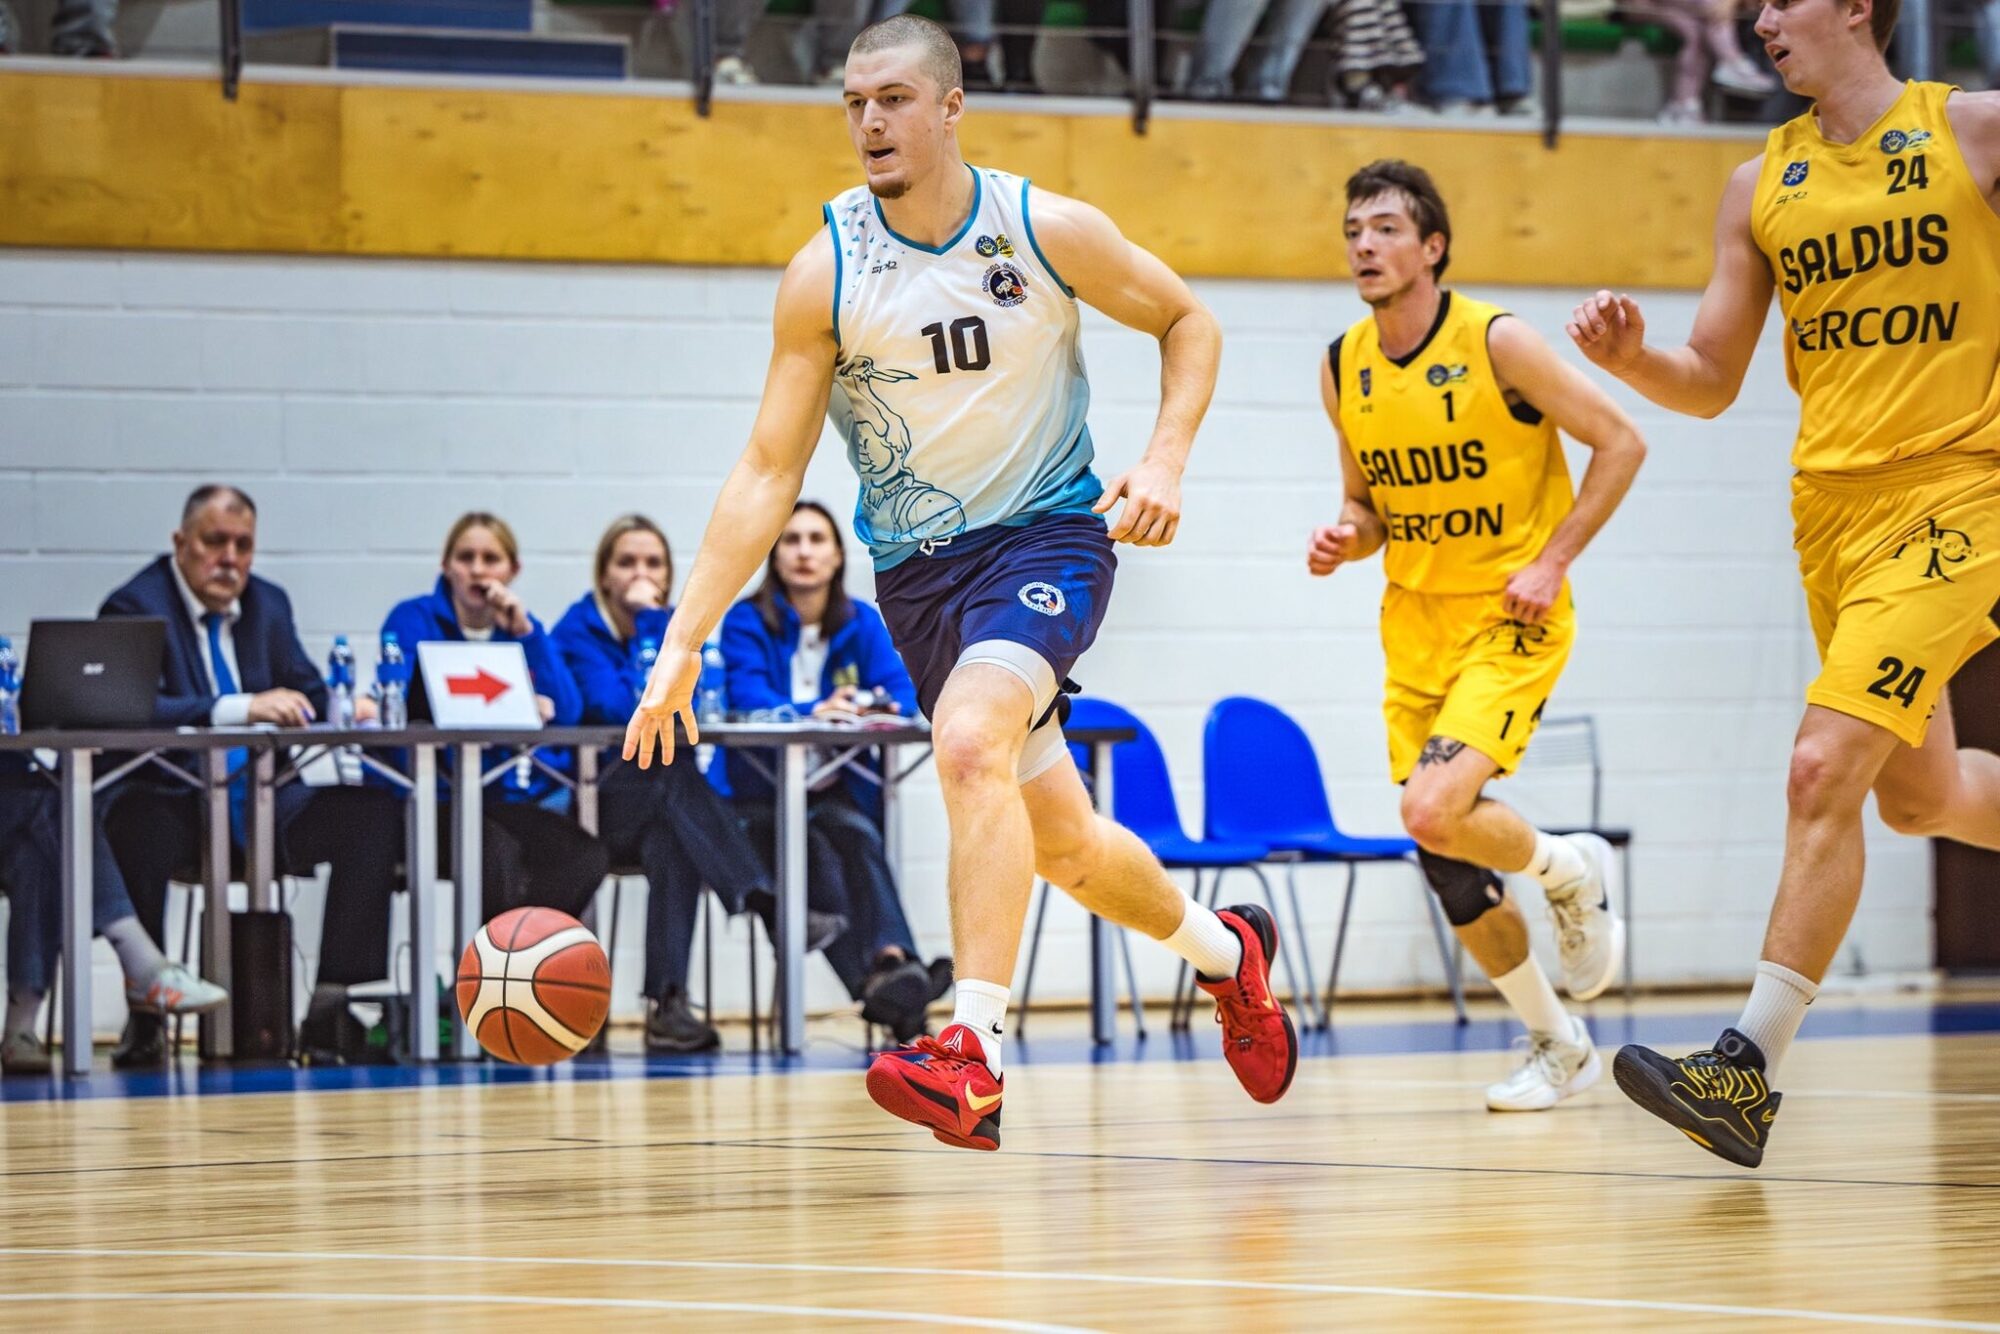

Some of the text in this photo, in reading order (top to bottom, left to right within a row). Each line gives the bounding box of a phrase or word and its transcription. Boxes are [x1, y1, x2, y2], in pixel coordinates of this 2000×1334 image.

[1886, 154, 1929, 195] 24
[1779, 214, 1949, 295] SALDUS
[921, 315, 991, 375] 10
[1791, 301, 1960, 352] ERCON
[1441, 390, 1455, 423] 1
[1360, 439, 1488, 487] SALDUS
[1384, 502, 1503, 545] ERCON
[1866, 656, 1927, 709] 24
[1499, 710, 1515, 741] 1
